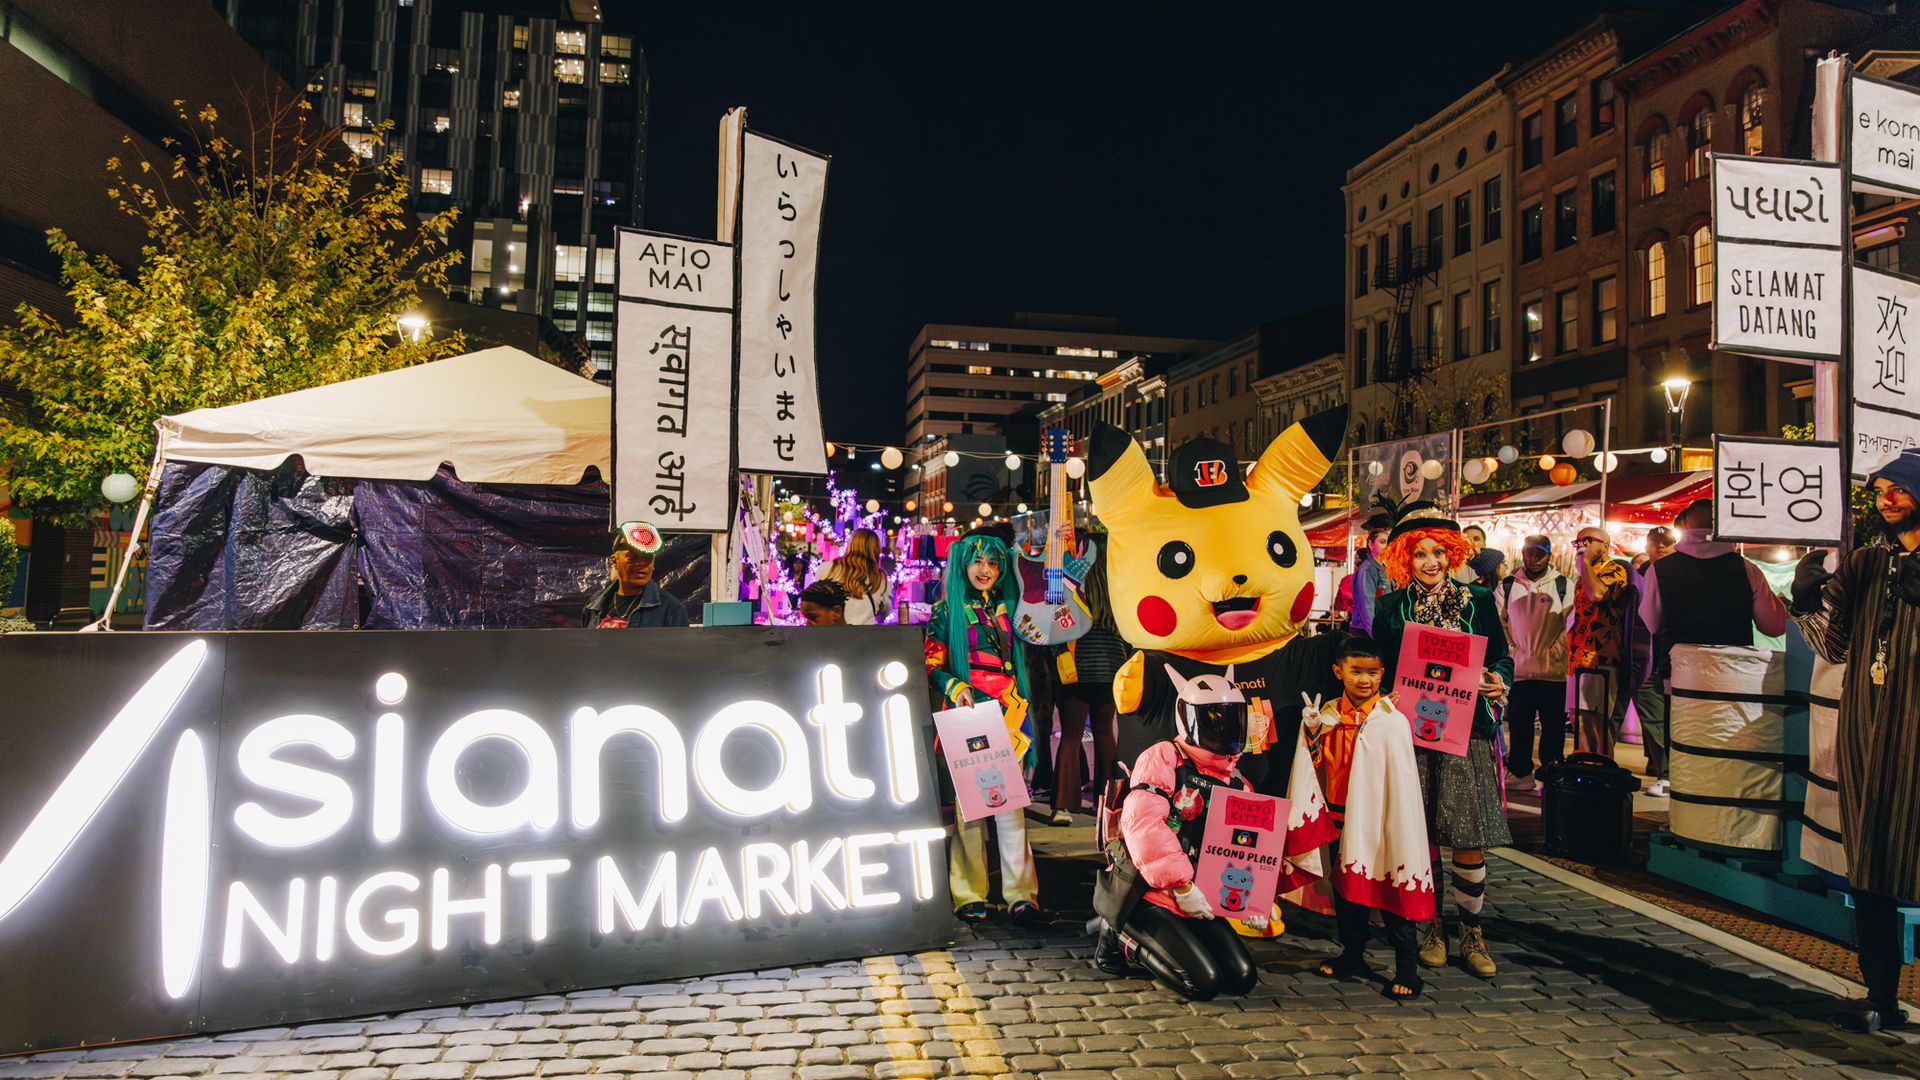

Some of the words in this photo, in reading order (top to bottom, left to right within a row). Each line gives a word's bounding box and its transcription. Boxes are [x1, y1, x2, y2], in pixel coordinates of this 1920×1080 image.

[1859, 112, 1871, 129] e
[1878, 147, 1914, 170] mai
[1726, 176, 1829, 224] પધારો
[638, 242, 711, 270] AFIO
[649, 267, 703, 292] MAI
[1731, 268, 1825, 301] SELAMAT
[773, 153, 799, 461] いらっしゃいませ
[1739, 304, 1816, 340] DATANG
[1872, 295, 1908, 396] 欢迎
[648, 450, 696, 523] आहे
[1724, 461, 1823, 523] 환영
[1060, 612, 1076, 628] 01
[1423, 634, 1466, 651] TOKYO
[1423, 645, 1463, 662] KITTY
[1401, 676, 1435, 692] THIRD
[1437, 684, 1473, 701] PLACE
[953, 755, 980, 769] FIRST
[983, 748, 1011, 762] PLACE
[0, 638, 920, 1000] Asianati
[1230, 811, 1269, 827] KITTY
[1231, 800, 1271, 816] TOKYO
[1205, 845, 1245, 860] SECOND
[1247, 852, 1278, 866] PLACE
[222, 859, 571, 968] NIGHT
[598, 828, 947, 934] MARKET
